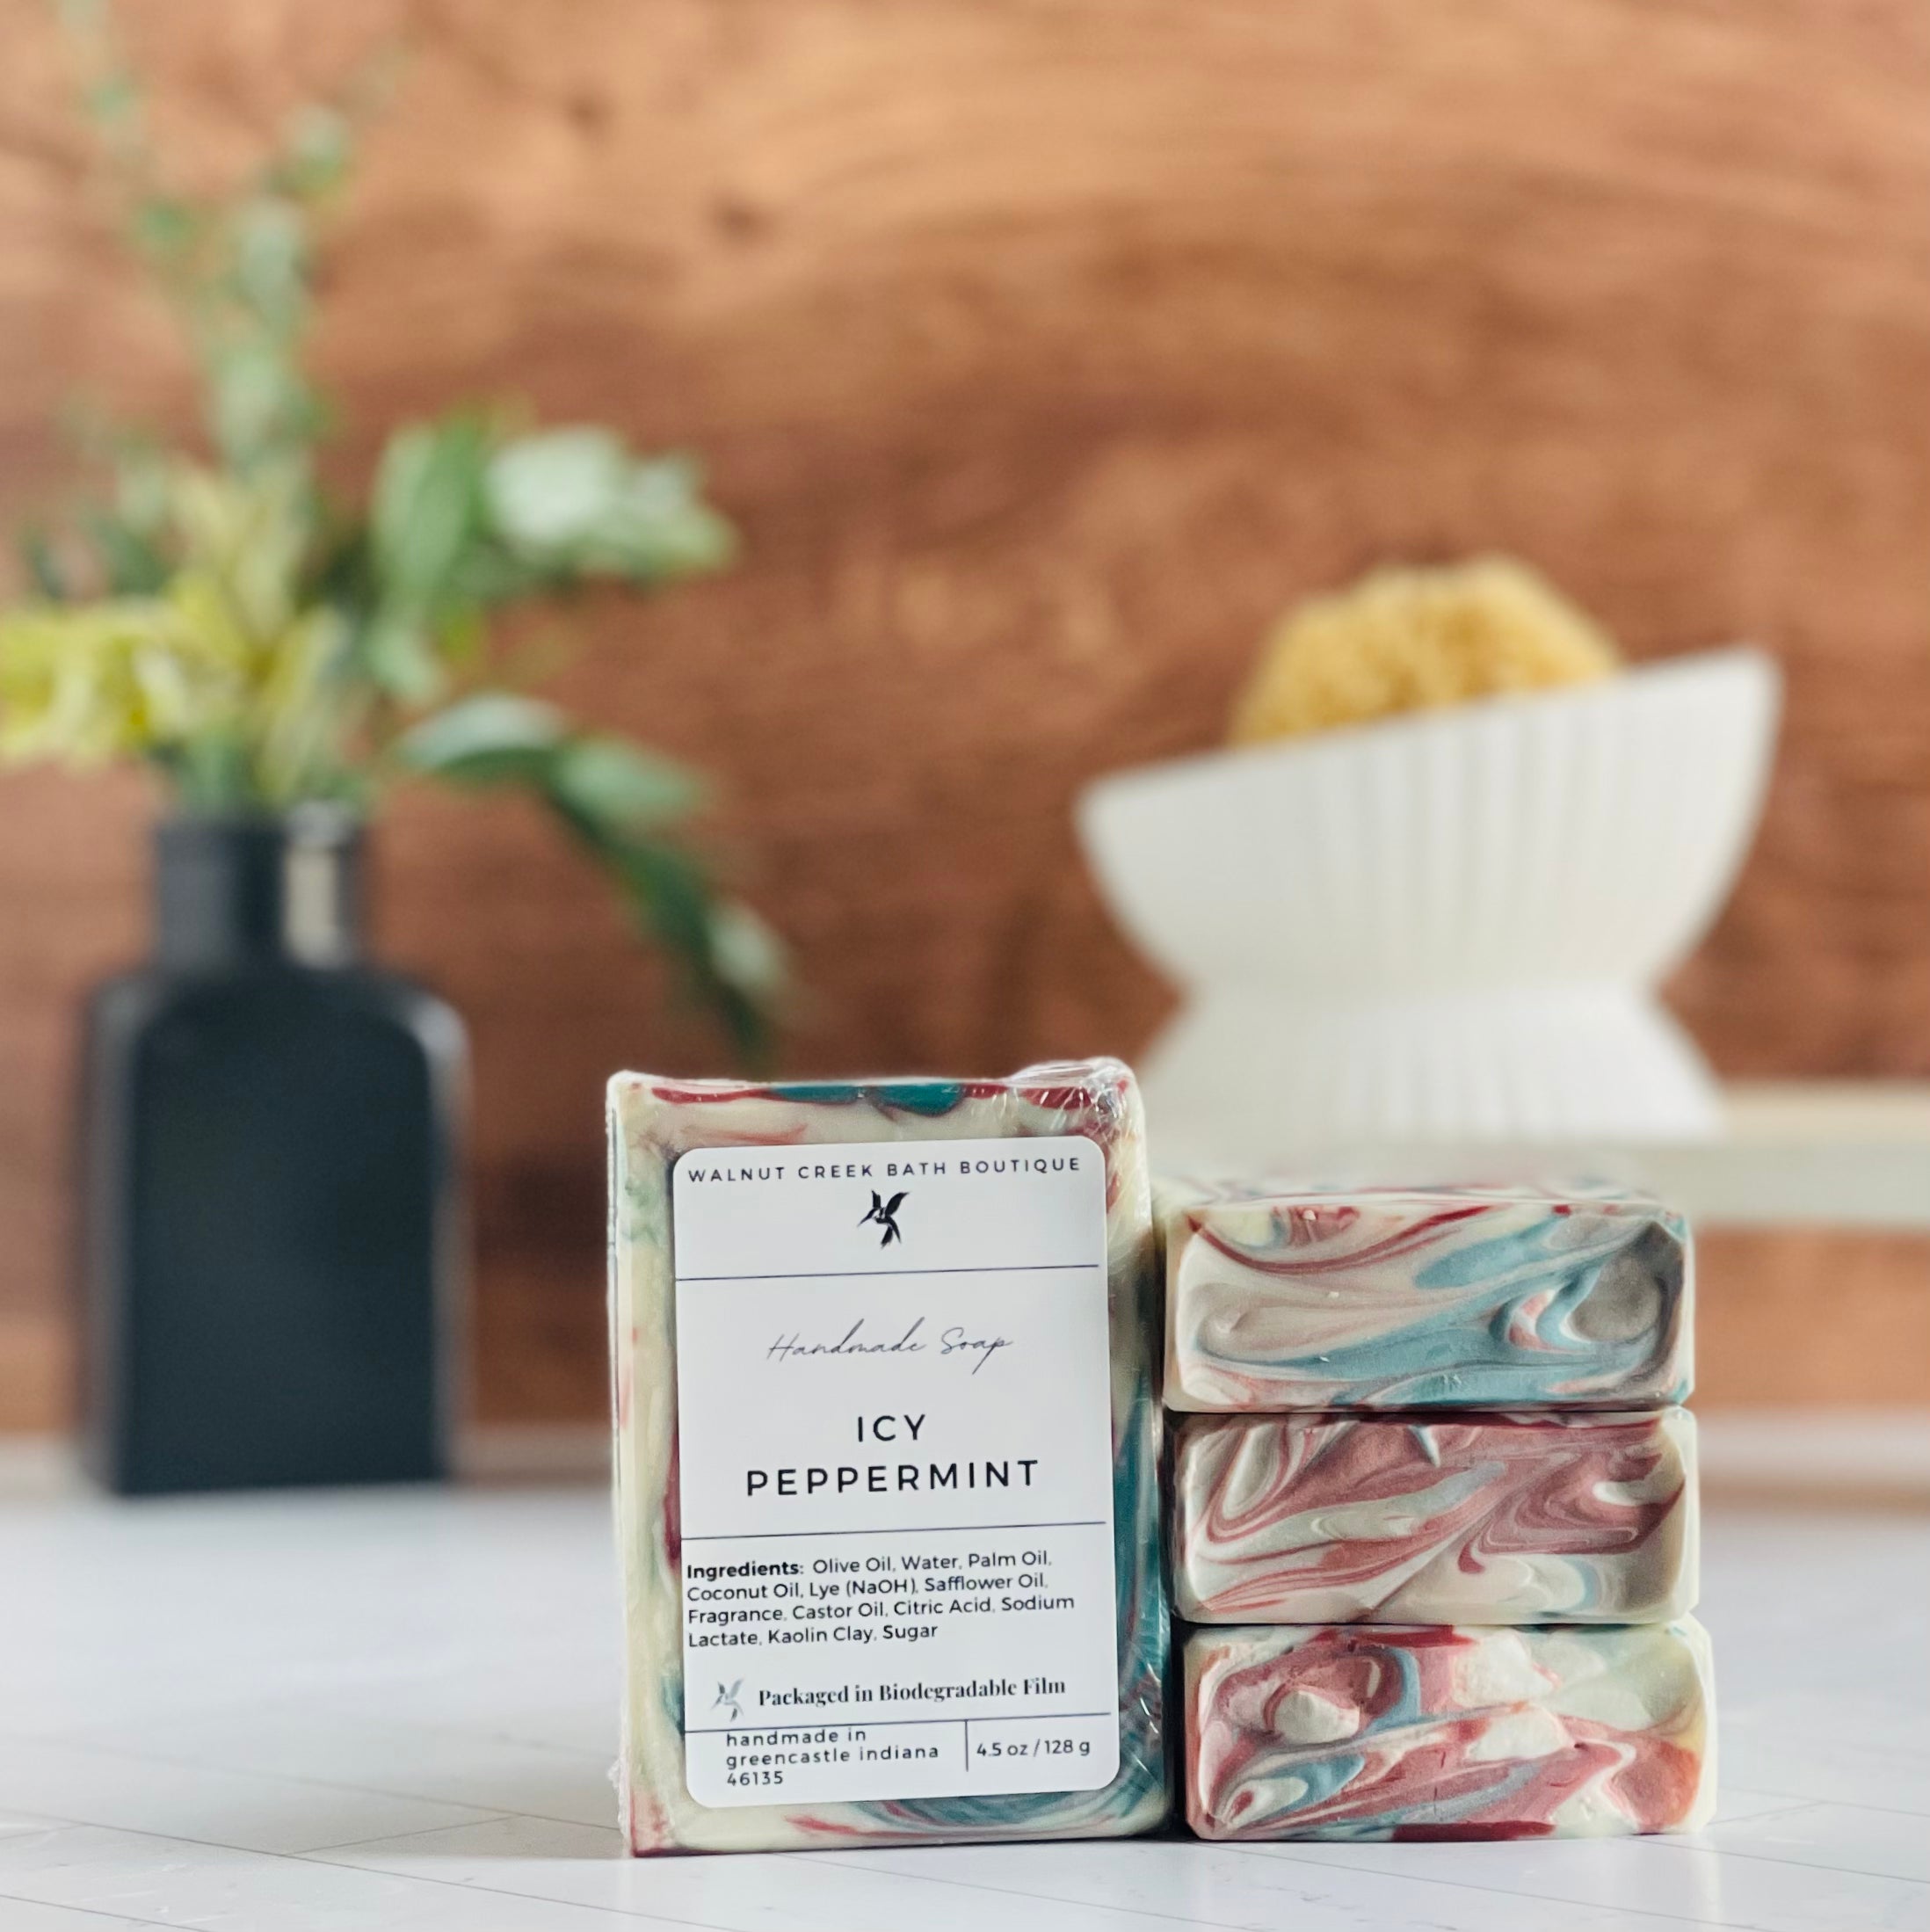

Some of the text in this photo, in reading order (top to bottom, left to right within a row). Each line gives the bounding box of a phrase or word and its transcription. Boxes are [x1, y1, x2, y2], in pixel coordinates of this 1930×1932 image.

[687, 1157, 1080, 1183] WALNUT CREEK BATH BOUTIQUE
[766, 1316, 1013, 1376] Handmade Soap
[857, 1413, 926, 1443] ICY
[746, 1458, 1039, 1498] PEPPERMINT
[686, 1559, 805, 1583] Ingredients:
[812, 1558, 861, 1575] Olive
[968, 1551, 1017, 1568] Palm
[686, 1584, 769, 1602] Coconut
[809, 1581, 840, 1601] Lye
[924, 1574, 1014, 1593] Safflower
[792, 1604, 854, 1621] Castor
[893, 1598, 944, 1616] Citric
[1000, 1594, 1075, 1612] Sodium
[767, 1626, 828, 1645] Kaolin
[882, 1623, 939, 1643] Sugar
[758, 1676, 1066, 1708] Packaged in Biodegradable Film
[725, 1727, 867, 1747] handmade in
[1006, 1743, 1029, 1756] oz
[1043, 1739, 1074, 1754] 128
[1078, 1740, 1091, 1757] g
[725, 1744, 939, 1771] greencastle indiana
[726, 1769, 784, 1787] 46135
